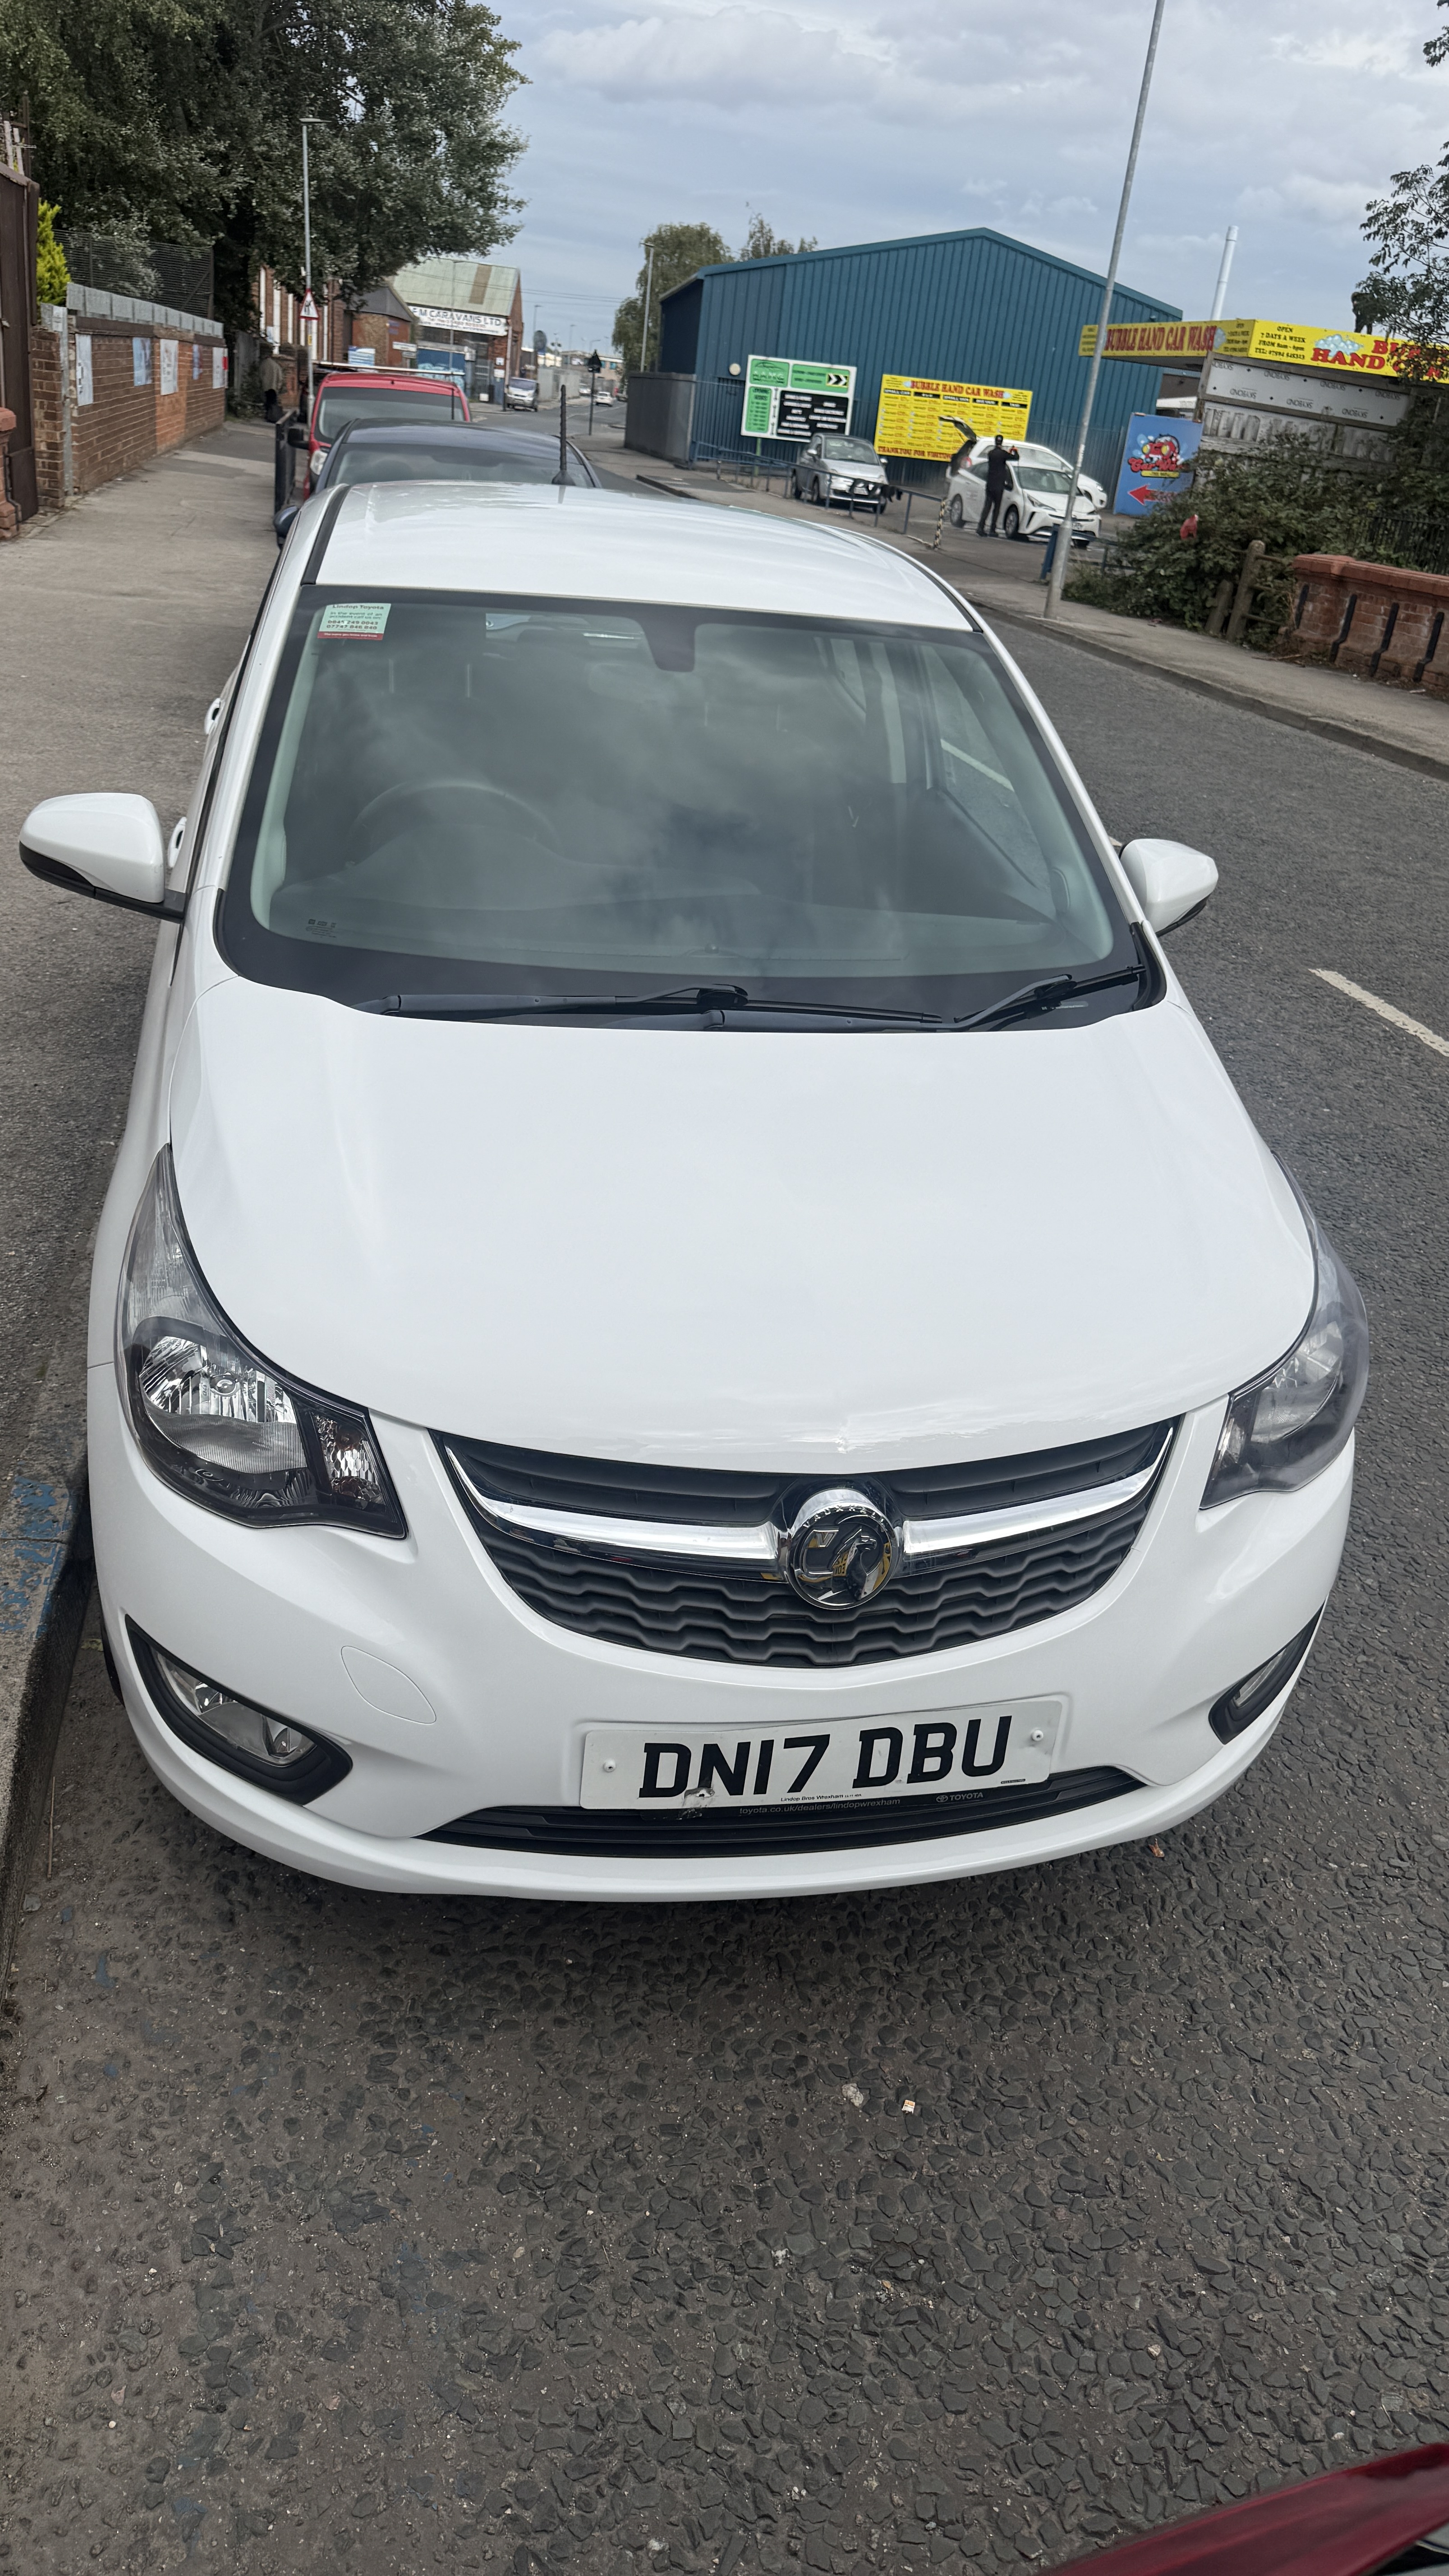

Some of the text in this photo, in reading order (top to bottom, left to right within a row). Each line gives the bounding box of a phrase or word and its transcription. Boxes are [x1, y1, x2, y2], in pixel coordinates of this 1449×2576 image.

[429, 309, 482, 323] CARAVANS
[483, 317, 502, 326] LTD
[1137, 327, 1165, 351] HAND
[1165, 326, 1186, 351] CAR
[1187, 325, 1217, 351] WASH
[1311, 348, 1385, 370] HAND
[911, 380, 940, 391] BUBBLE
[942, 383, 964, 394] HAND
[965, 386, 980, 396] CAR
[983, 388, 1004, 399] WASH
[1229, 388, 1257, 399] SKYBOND
[1128, 457, 1156, 473] Car
[639, 1715, 1012, 1798] DN17 DBU
[950, 1792, 984, 1801] TOYOTA
[739, 1799, 900, 1815] toyota.co.uk/dealers/lindopwrexham
